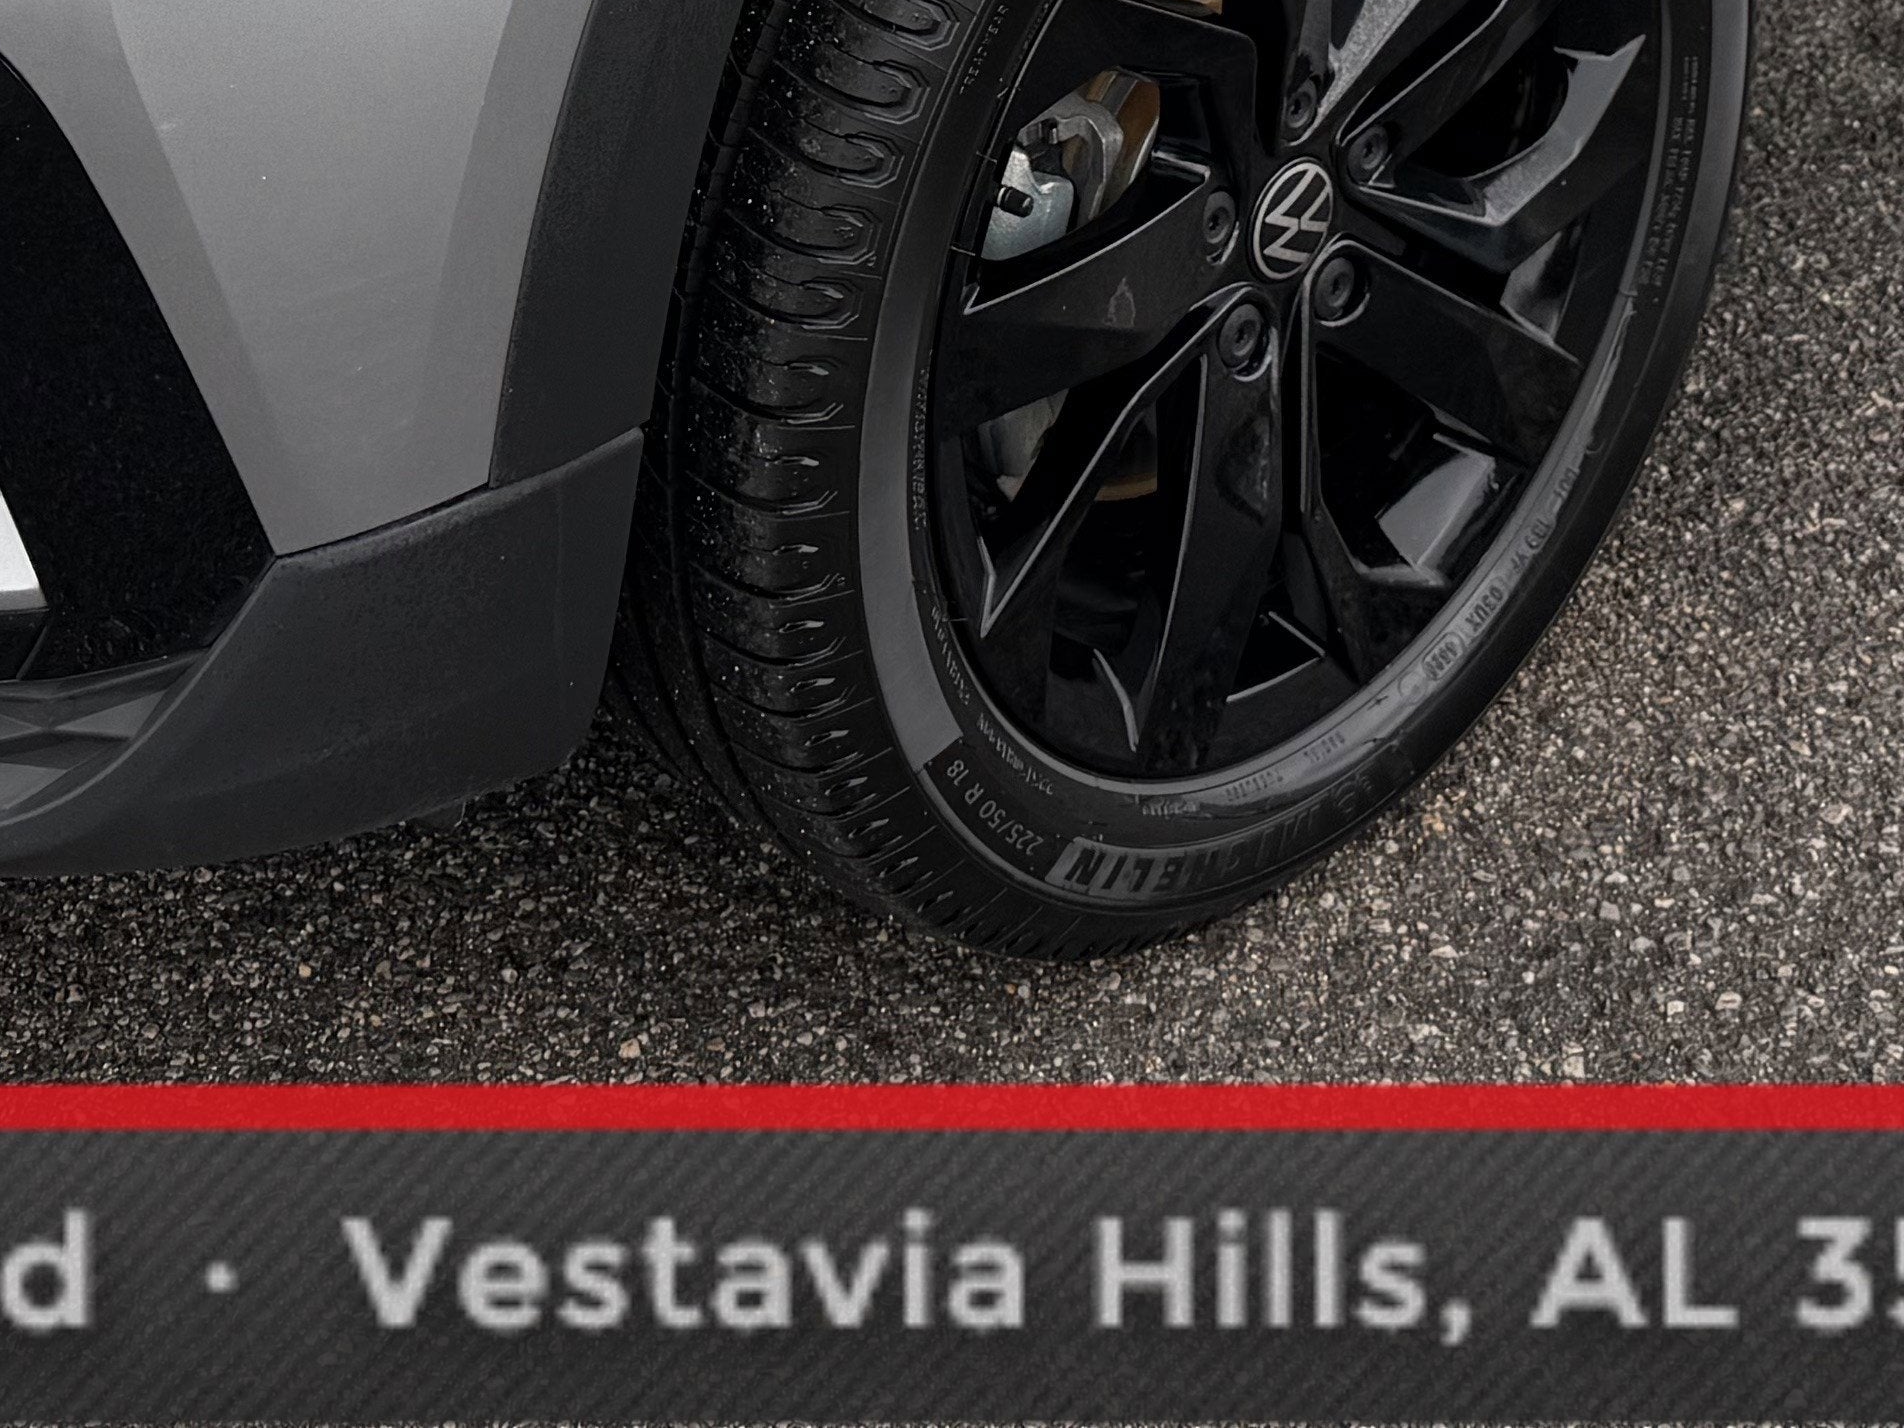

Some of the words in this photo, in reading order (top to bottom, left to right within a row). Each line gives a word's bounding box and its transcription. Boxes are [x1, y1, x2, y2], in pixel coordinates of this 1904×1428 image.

[946, 759, 970, 787] 18
[964, 782, 984, 805] R
[978, 799, 1044, 856] 225/50
